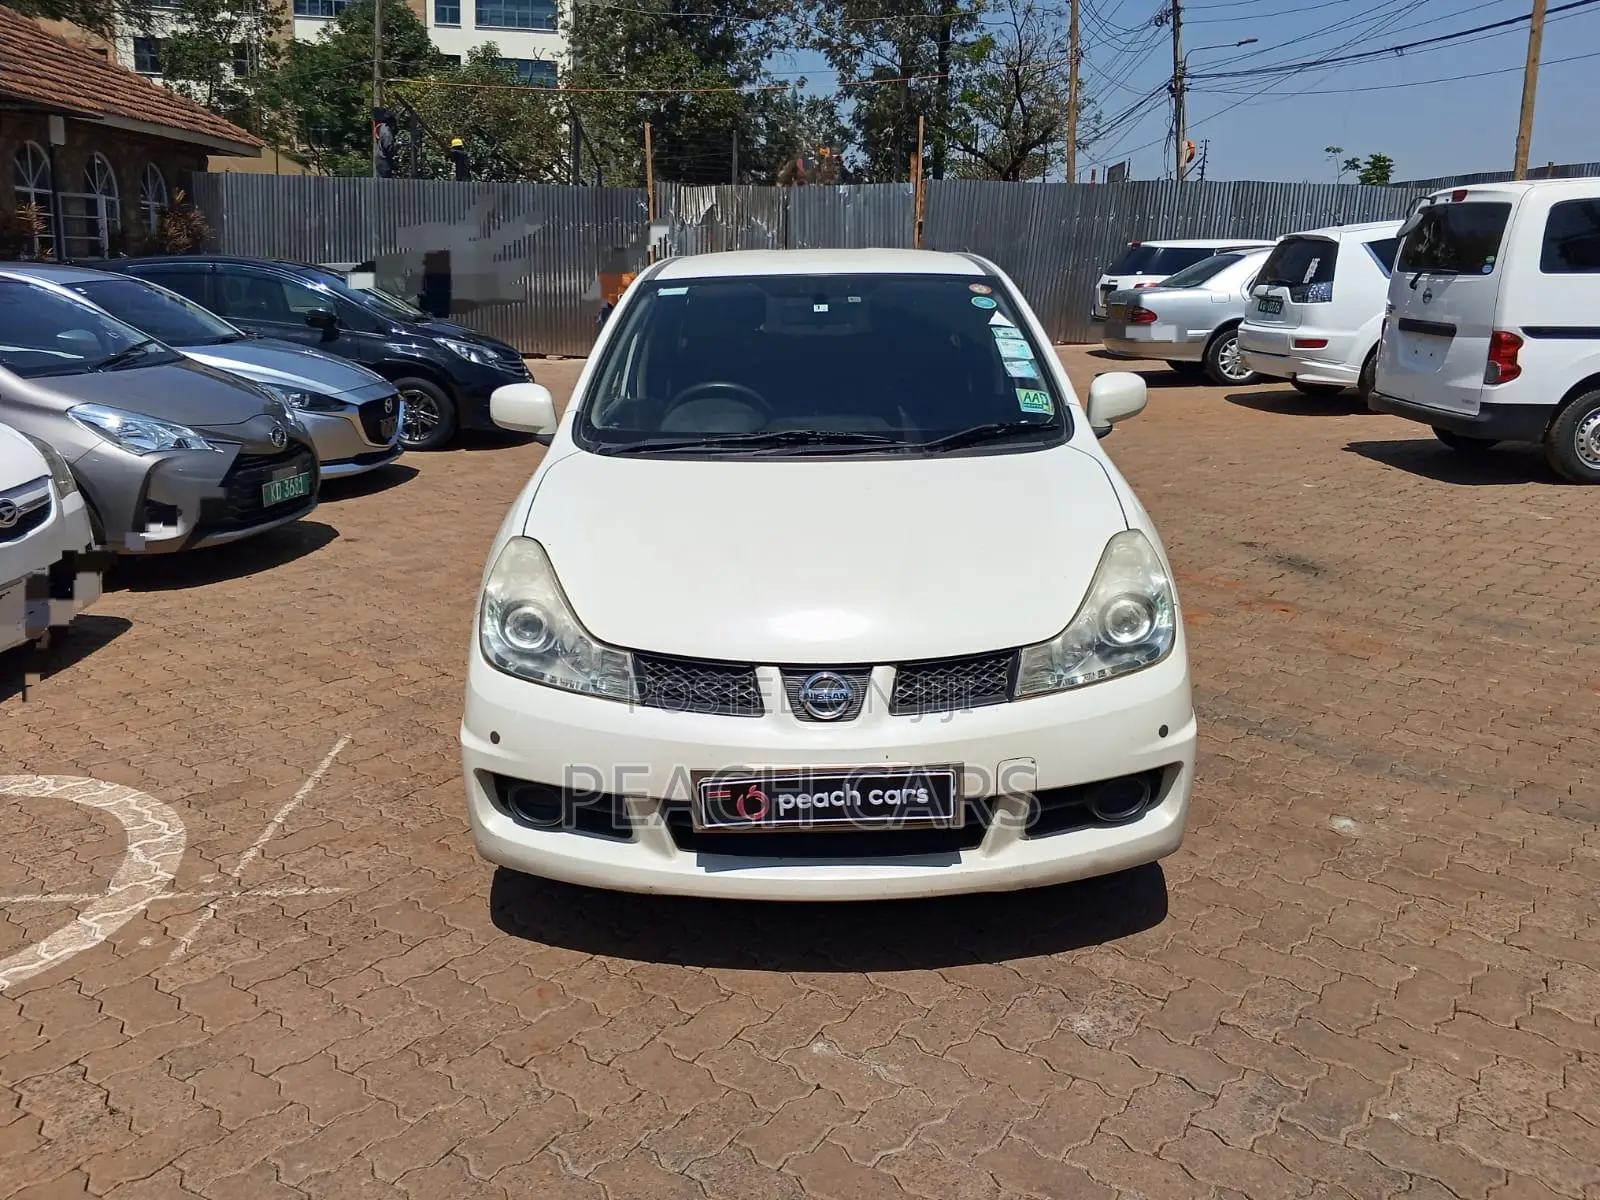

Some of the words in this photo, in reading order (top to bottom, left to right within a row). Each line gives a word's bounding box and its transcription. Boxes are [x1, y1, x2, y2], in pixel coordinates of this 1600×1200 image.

[803, 690, 849, 701] NISSAN
[778, 783, 861, 817] peach
[868, 786, 929, 806] cars
